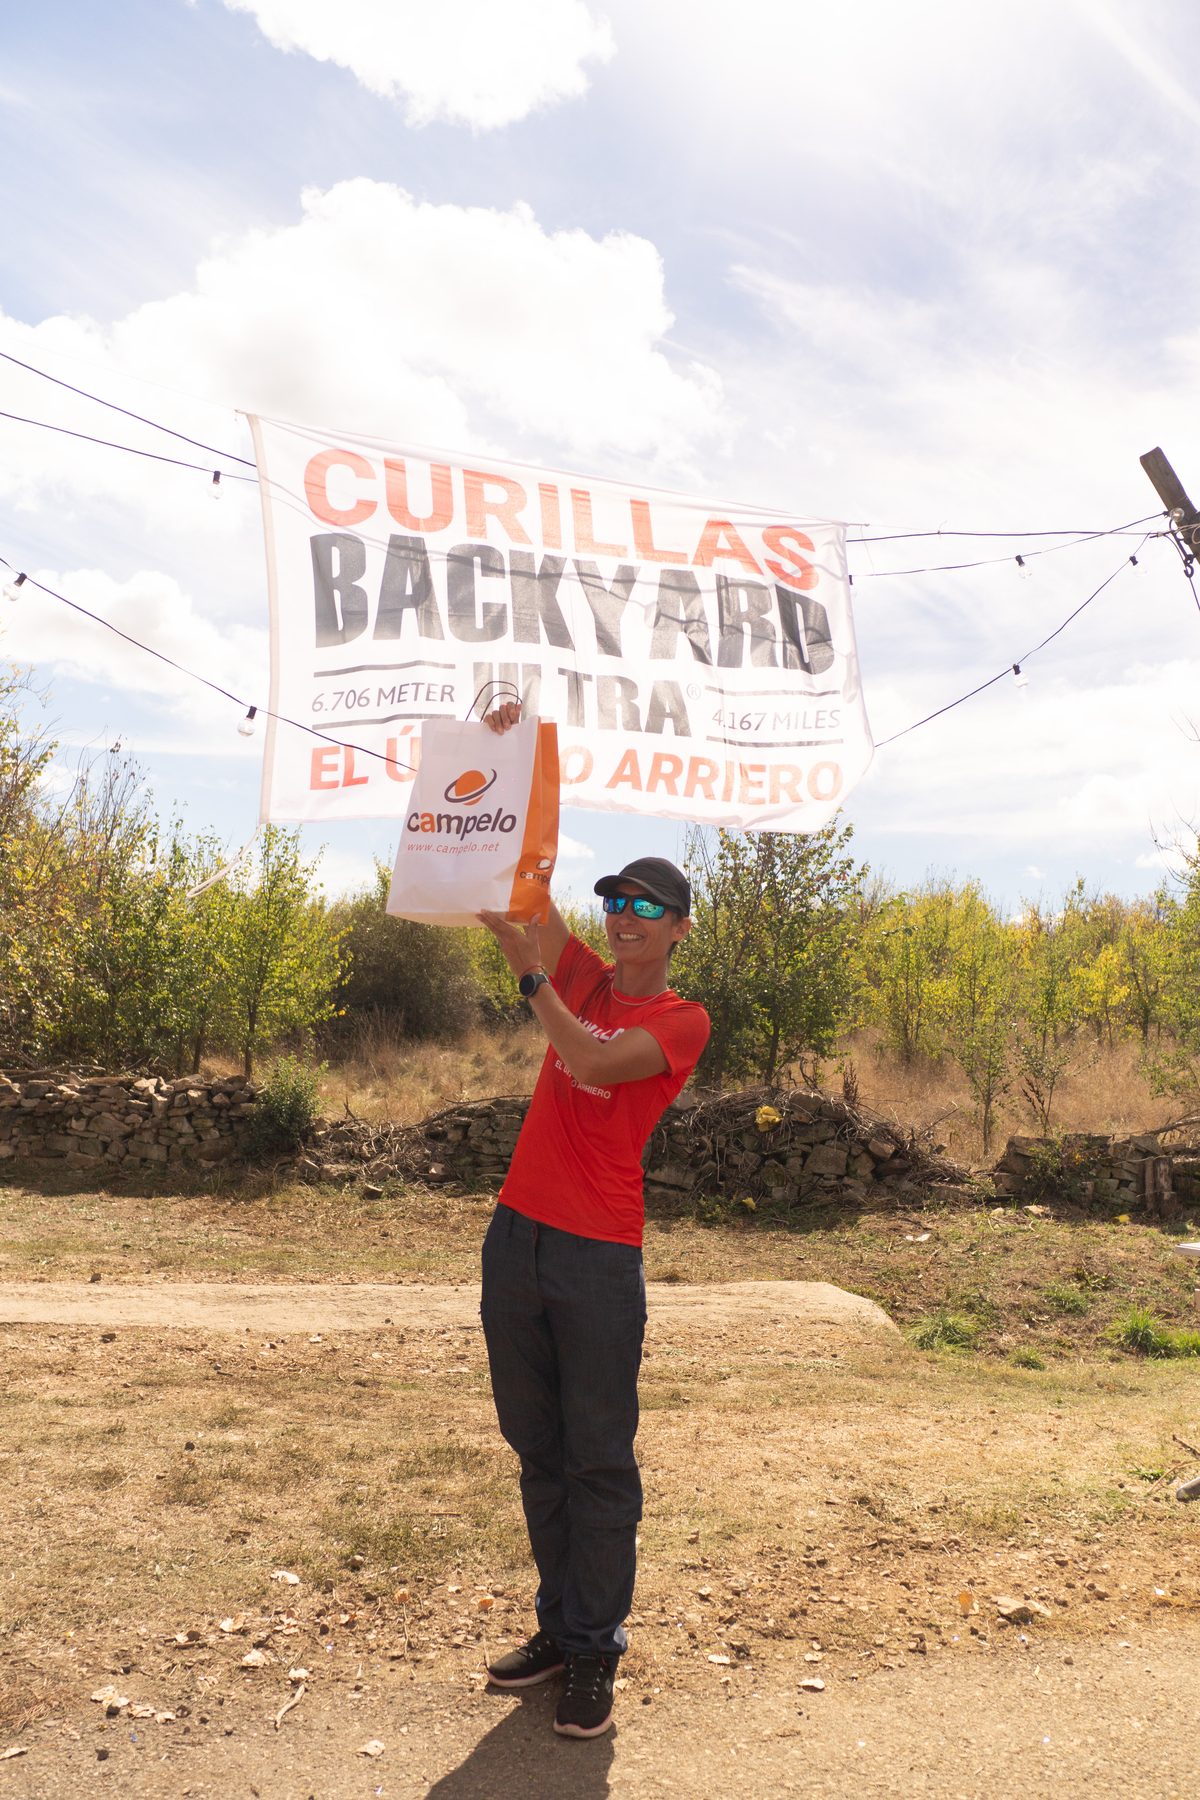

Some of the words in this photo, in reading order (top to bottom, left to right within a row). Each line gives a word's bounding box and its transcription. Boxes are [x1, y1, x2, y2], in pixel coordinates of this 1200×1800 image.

[304, 448, 820, 591] CURILLAS
[309, 532, 835, 675] BACKYARD
[311, 688, 370, 712] 6.706
[376, 682, 455, 707] METER
[711, 708, 768, 731] 4.167
[772, 709, 841, 731] MILES
[309, 744, 369, 790] EL
[605, 748, 844, 805] ARRIERO
[406, 807, 517, 841] campelo
[407, 842, 500, 856] www.campelo.net
[554, 1059, 563, 1071] EL
[577, 1082, 611, 1099] ARRIERO
